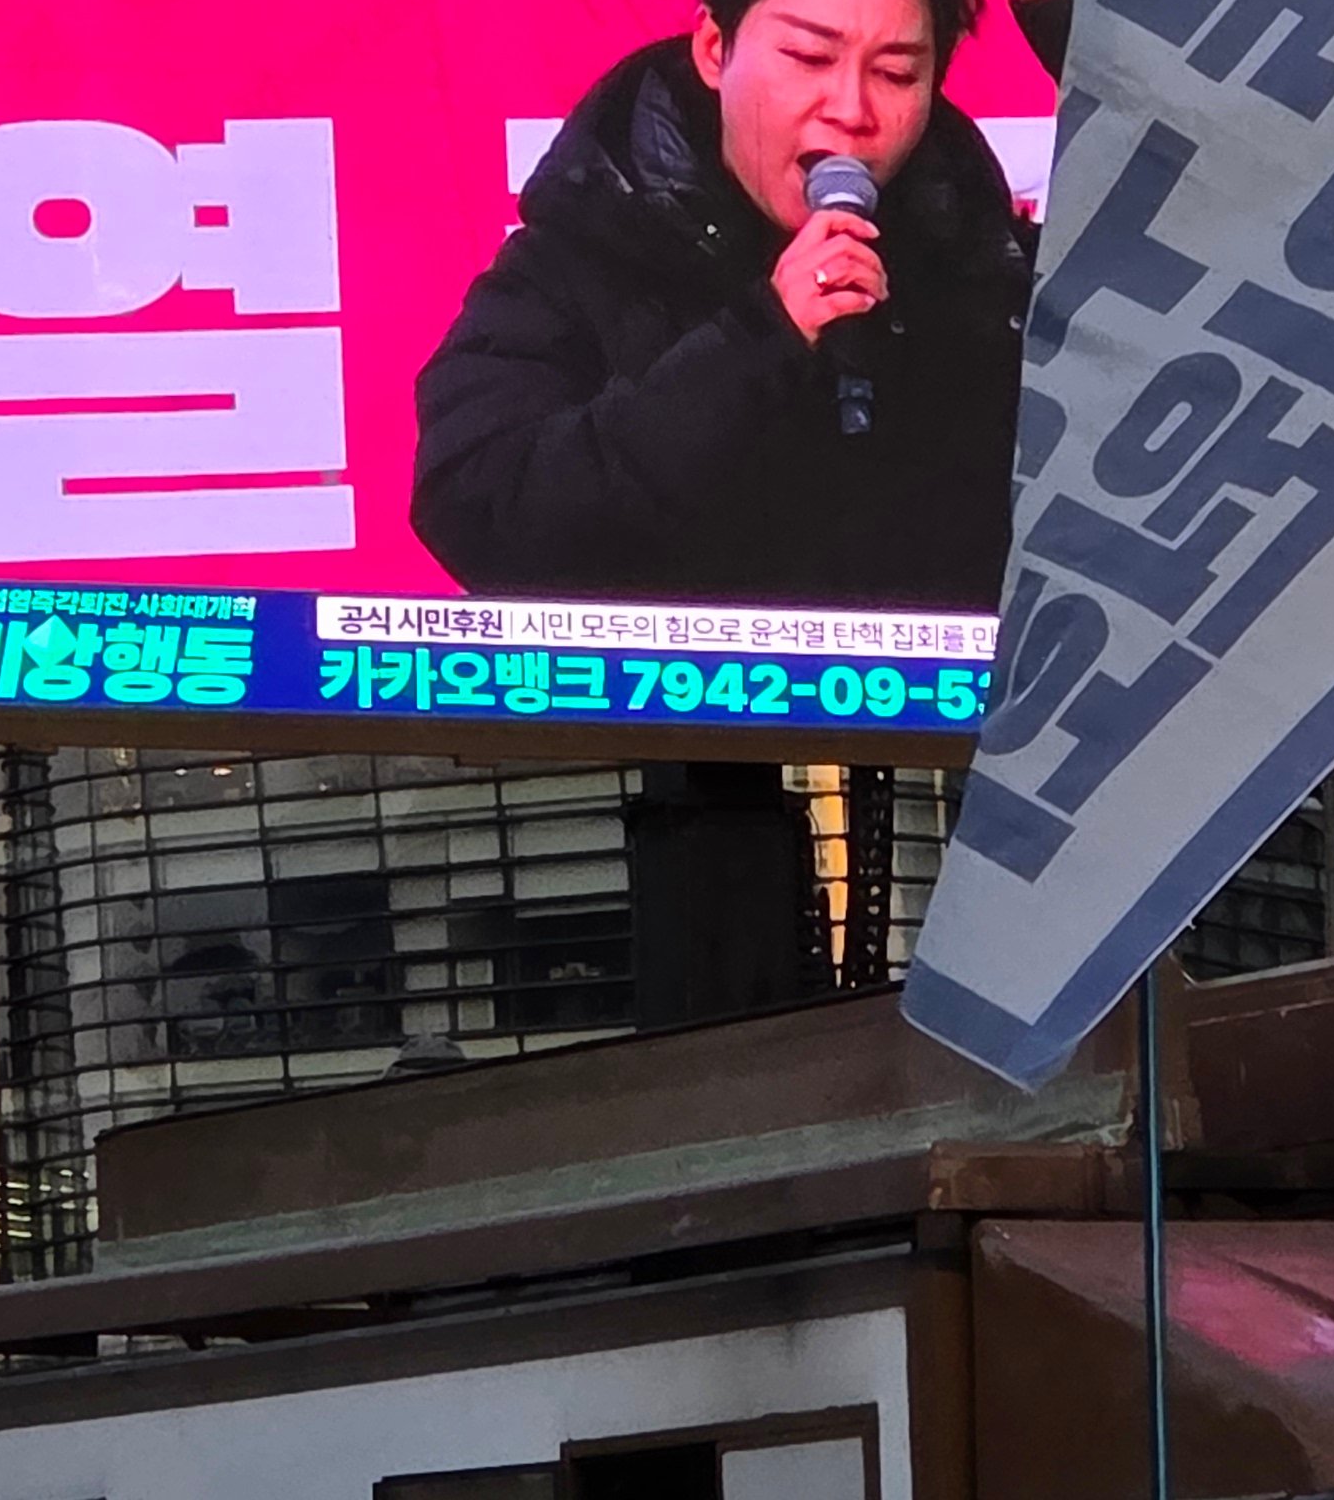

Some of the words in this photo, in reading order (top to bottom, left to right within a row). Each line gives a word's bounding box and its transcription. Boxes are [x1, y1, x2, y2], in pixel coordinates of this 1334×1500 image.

[338, 605, 391, 635] 공식
[398, 607, 503, 639] 시민후원
[521, 610, 572, 640] 시민
[582, 612, 657, 643] 모두의
[665, 615, 742, 644] 힘으로
[749, 618, 825, 649] 윤석열
[834, 620, 883, 649] 탄핵
[891, 623, 965, 653] 집회를
[319, 646, 610, 713] 카카오뱅크
